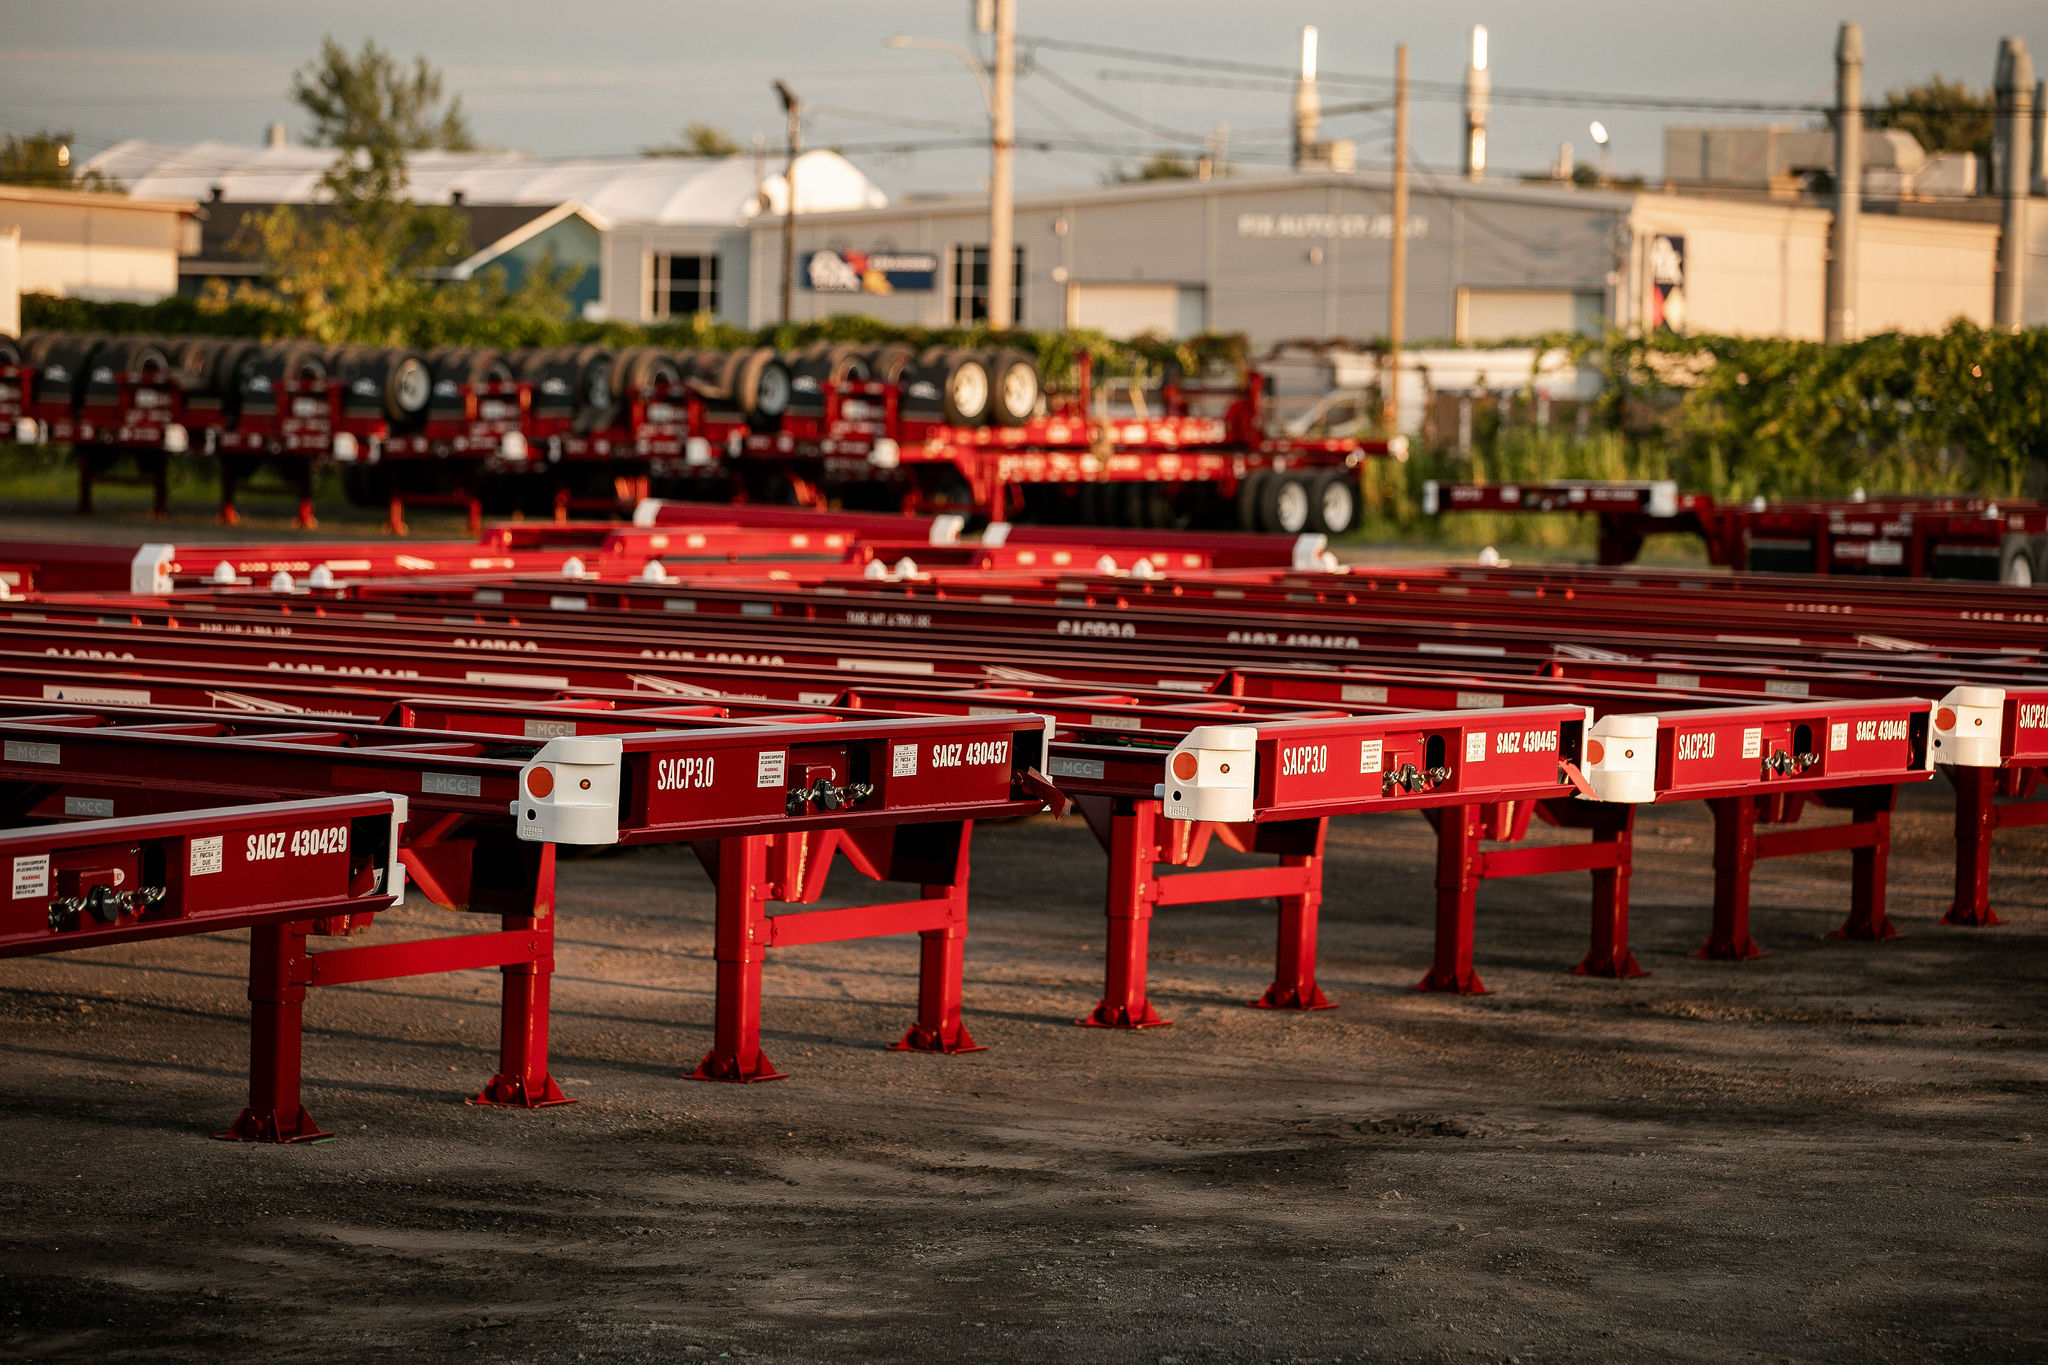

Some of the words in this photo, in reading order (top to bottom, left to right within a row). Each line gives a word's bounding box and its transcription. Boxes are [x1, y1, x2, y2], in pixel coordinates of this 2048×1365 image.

[1496, 732, 1521, 754] SACZ
[1523, 730, 1557, 753] 430445
[1856, 721, 1876, 742] SACZ
[1878, 720, 1907, 741] 430446
[932, 743, 963, 768] SACZ
[965, 741, 1009, 766] 430437
[1678, 732, 1716, 761] SACP3.0
[1062, 761, 1092, 774] MCC
[1282, 744, 1327, 776] SACP3.0
[436, 776, 466, 792] MCC
[657, 756, 715, 791] SACP3.0
[77, 800, 103, 813] MCC
[245, 832, 286, 862] SACZ
[290, 826, 348, 857] 430429
